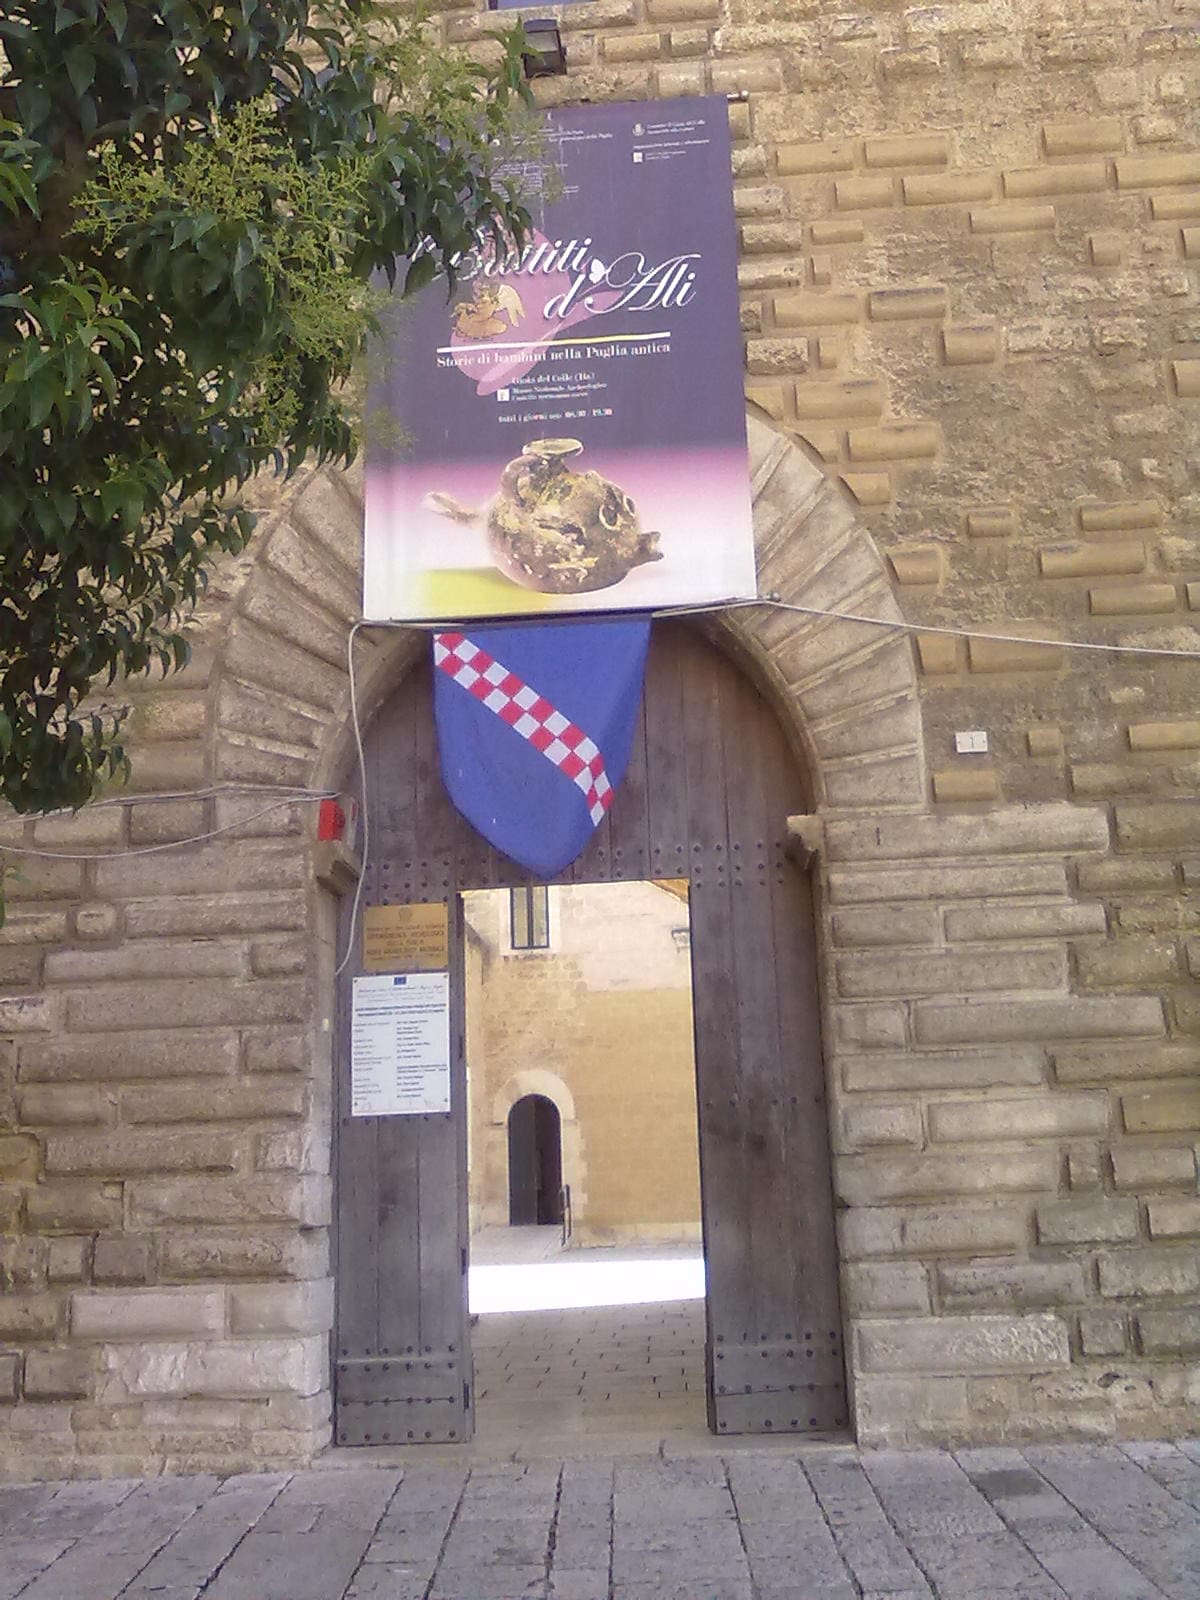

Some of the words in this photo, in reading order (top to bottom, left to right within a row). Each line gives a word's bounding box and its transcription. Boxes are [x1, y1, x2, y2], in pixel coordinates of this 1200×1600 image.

[436, 356, 473, 368] Storie
[477, 352, 490, 365] di
[494, 350, 547, 364] bambini
[550, 347, 582, 361] nella
[586, 344, 628, 359] Puglia
[630, 341, 671, 356] antica
